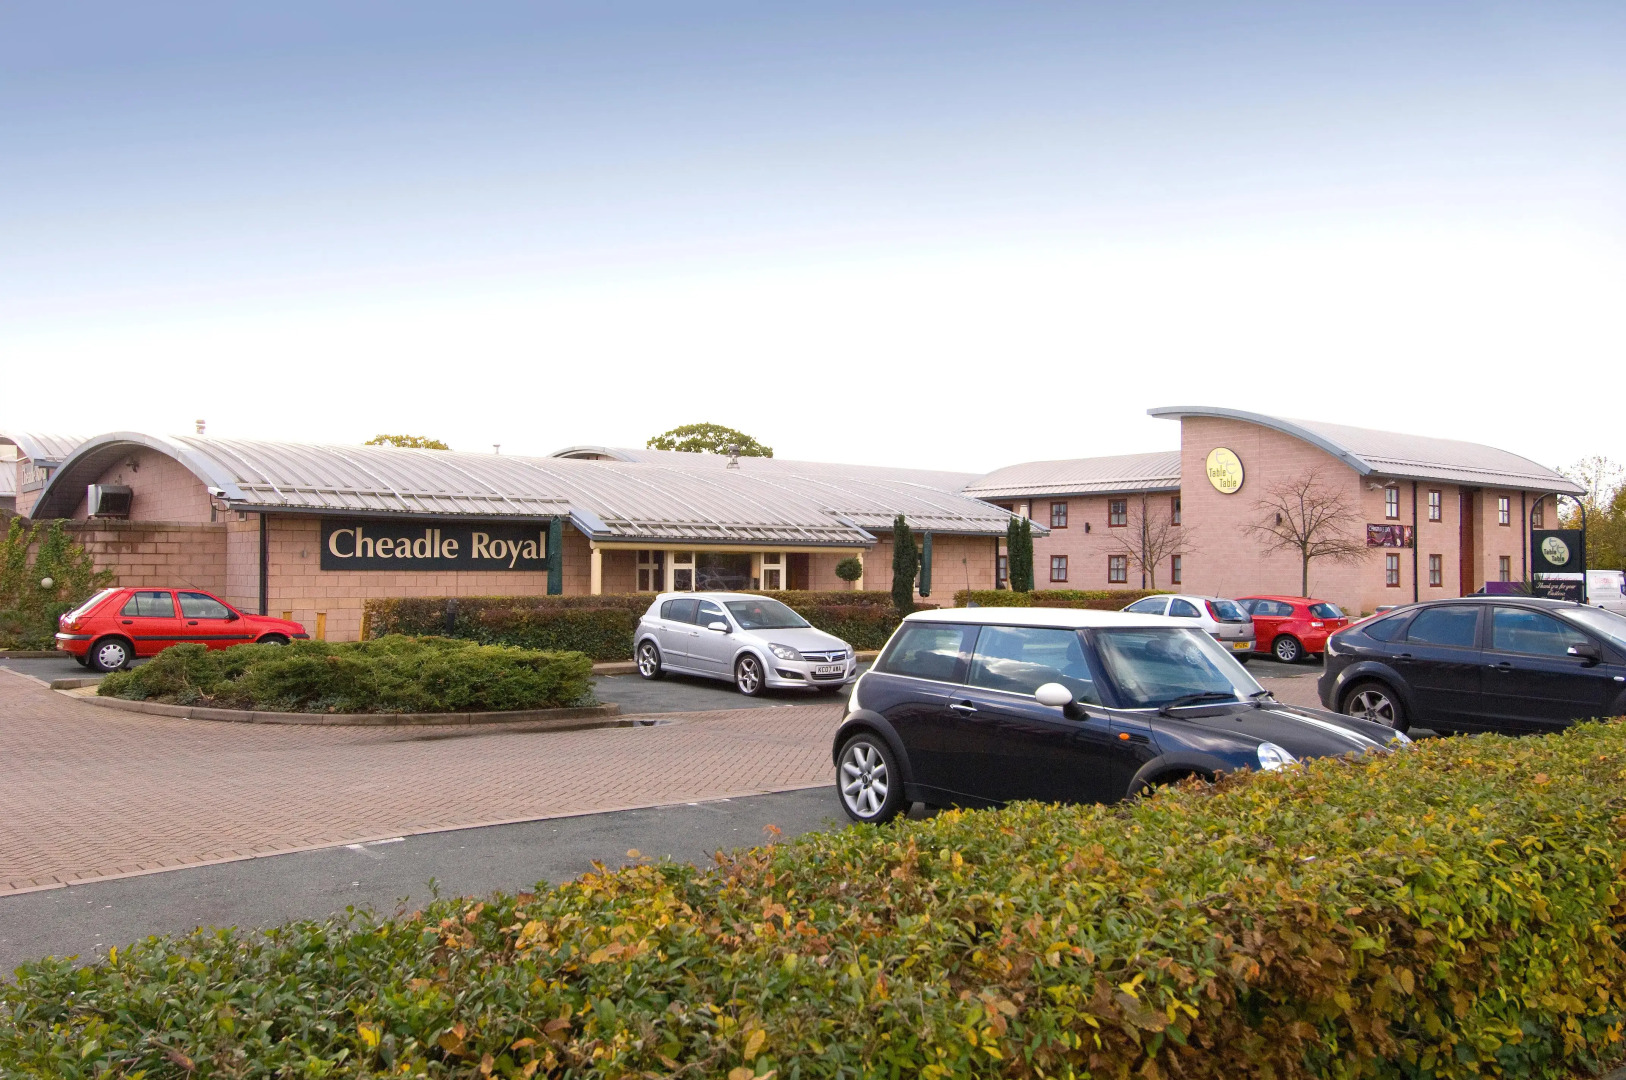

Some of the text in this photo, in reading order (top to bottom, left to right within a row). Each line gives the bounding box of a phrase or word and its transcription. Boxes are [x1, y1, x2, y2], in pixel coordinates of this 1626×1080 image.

[1209, 465, 1226, 477] Table
[1219, 475, 1237, 488] Table
[328, 526, 546, 569] Cheadle Royal
